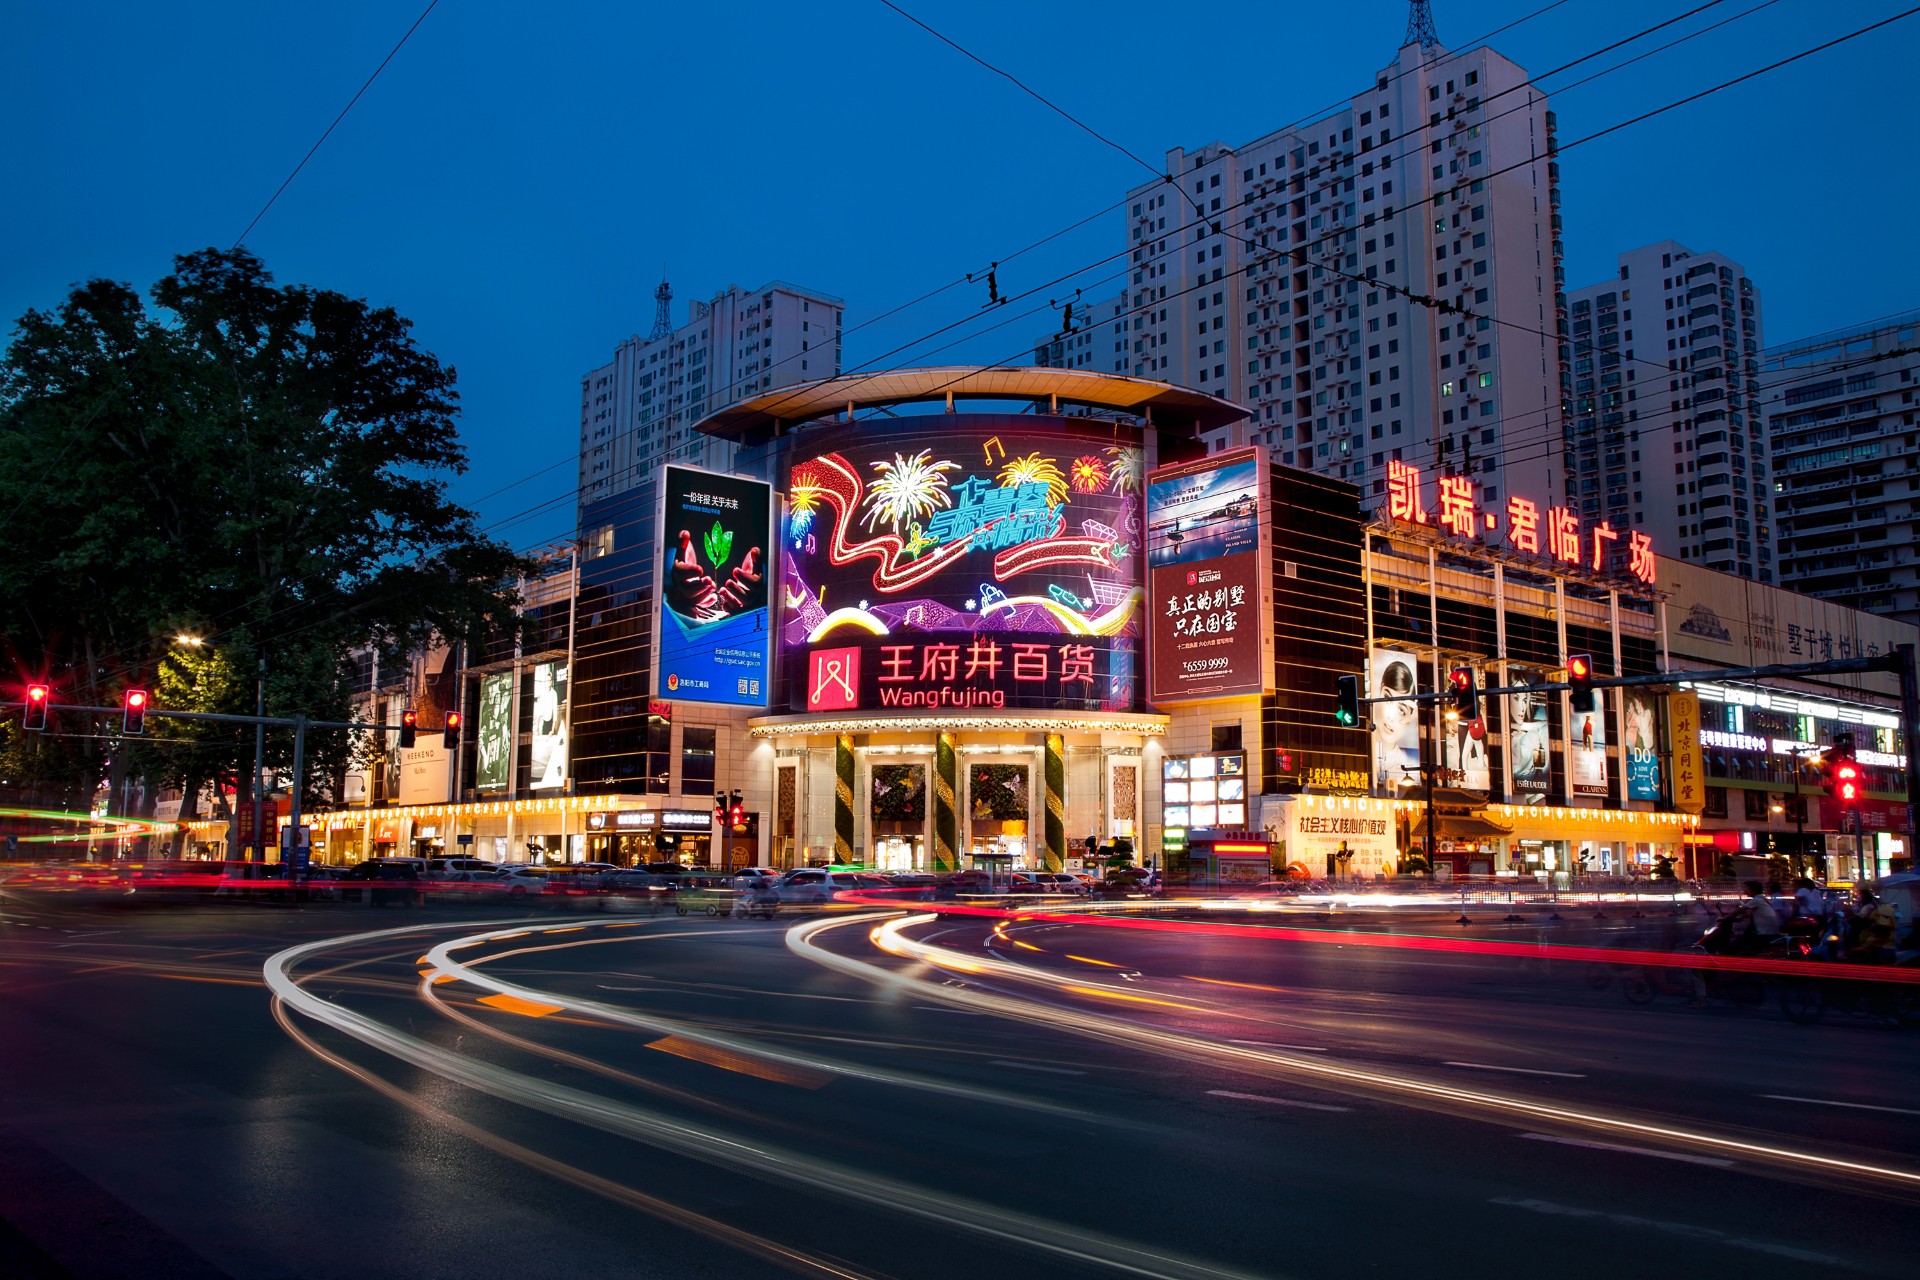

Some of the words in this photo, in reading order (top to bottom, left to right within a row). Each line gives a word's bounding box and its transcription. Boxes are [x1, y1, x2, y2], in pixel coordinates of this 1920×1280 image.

[683, 492, 711, 505] 一份年报
[712, 495, 739, 510] 关乎未来
[1387, 460, 1656, 584] 凯瑞·君临广场
[1165, 585, 1246, 617] 真正的别墅
[1173, 610, 1238, 638] 只在国宝
[878, 641, 1095, 684] 王府井百货
[1187, 659, 1207, 671] 6559
[1208, 657, 1229, 669] 9999
[879, 687, 1005, 709] Wangfujing
[407, 749, 435, 761] WEEKEND
[1634, 747, 1651, 764] DO
[1677, 718, 1694, 800] 北京同仁堂
[1582, 785, 1608, 794] CLARINS
[1299, 816, 1387, 835] 社会主义核心价值观
